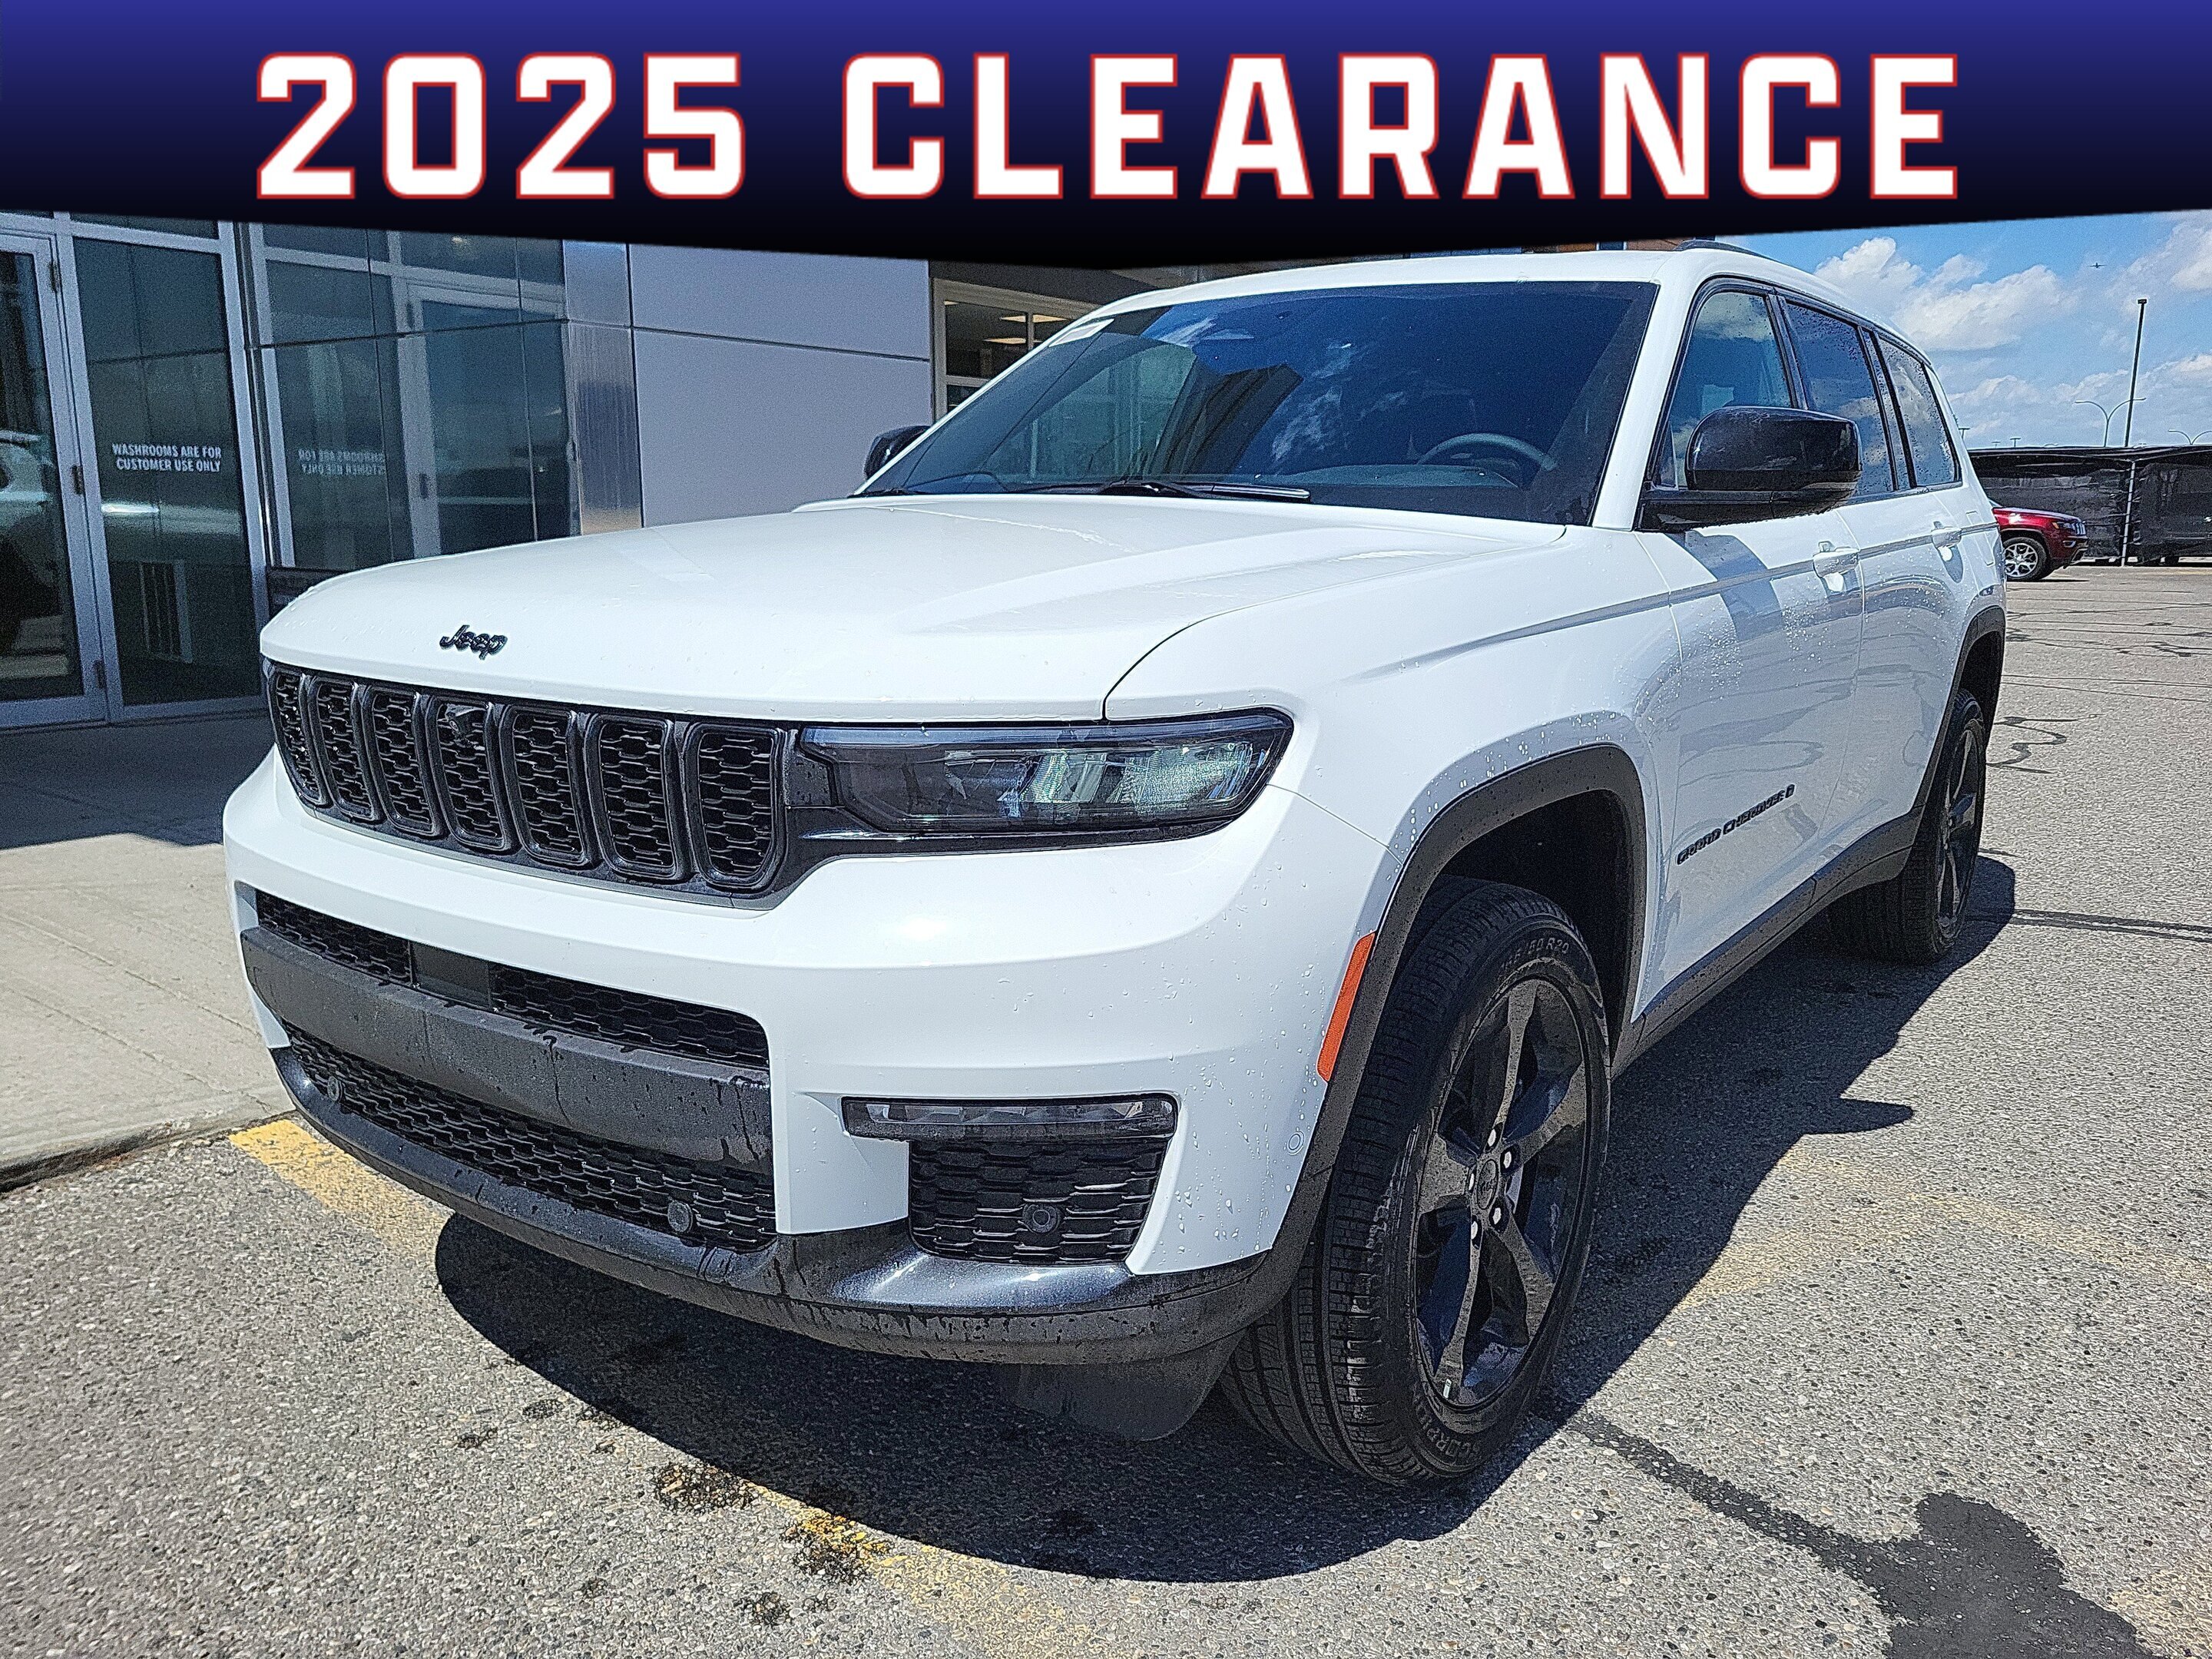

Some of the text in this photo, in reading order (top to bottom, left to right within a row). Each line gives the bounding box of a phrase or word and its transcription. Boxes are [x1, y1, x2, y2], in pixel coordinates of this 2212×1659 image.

[112, 443, 222, 459] WASHROOMS ARE FOR
[117, 457, 220, 472] CUSTOMER USE ONLY
[439, 624, 508, 661] Jeep
[1677, 828, 1722, 865] GRAND
[1724, 790, 1786, 835] CHEROKEE
